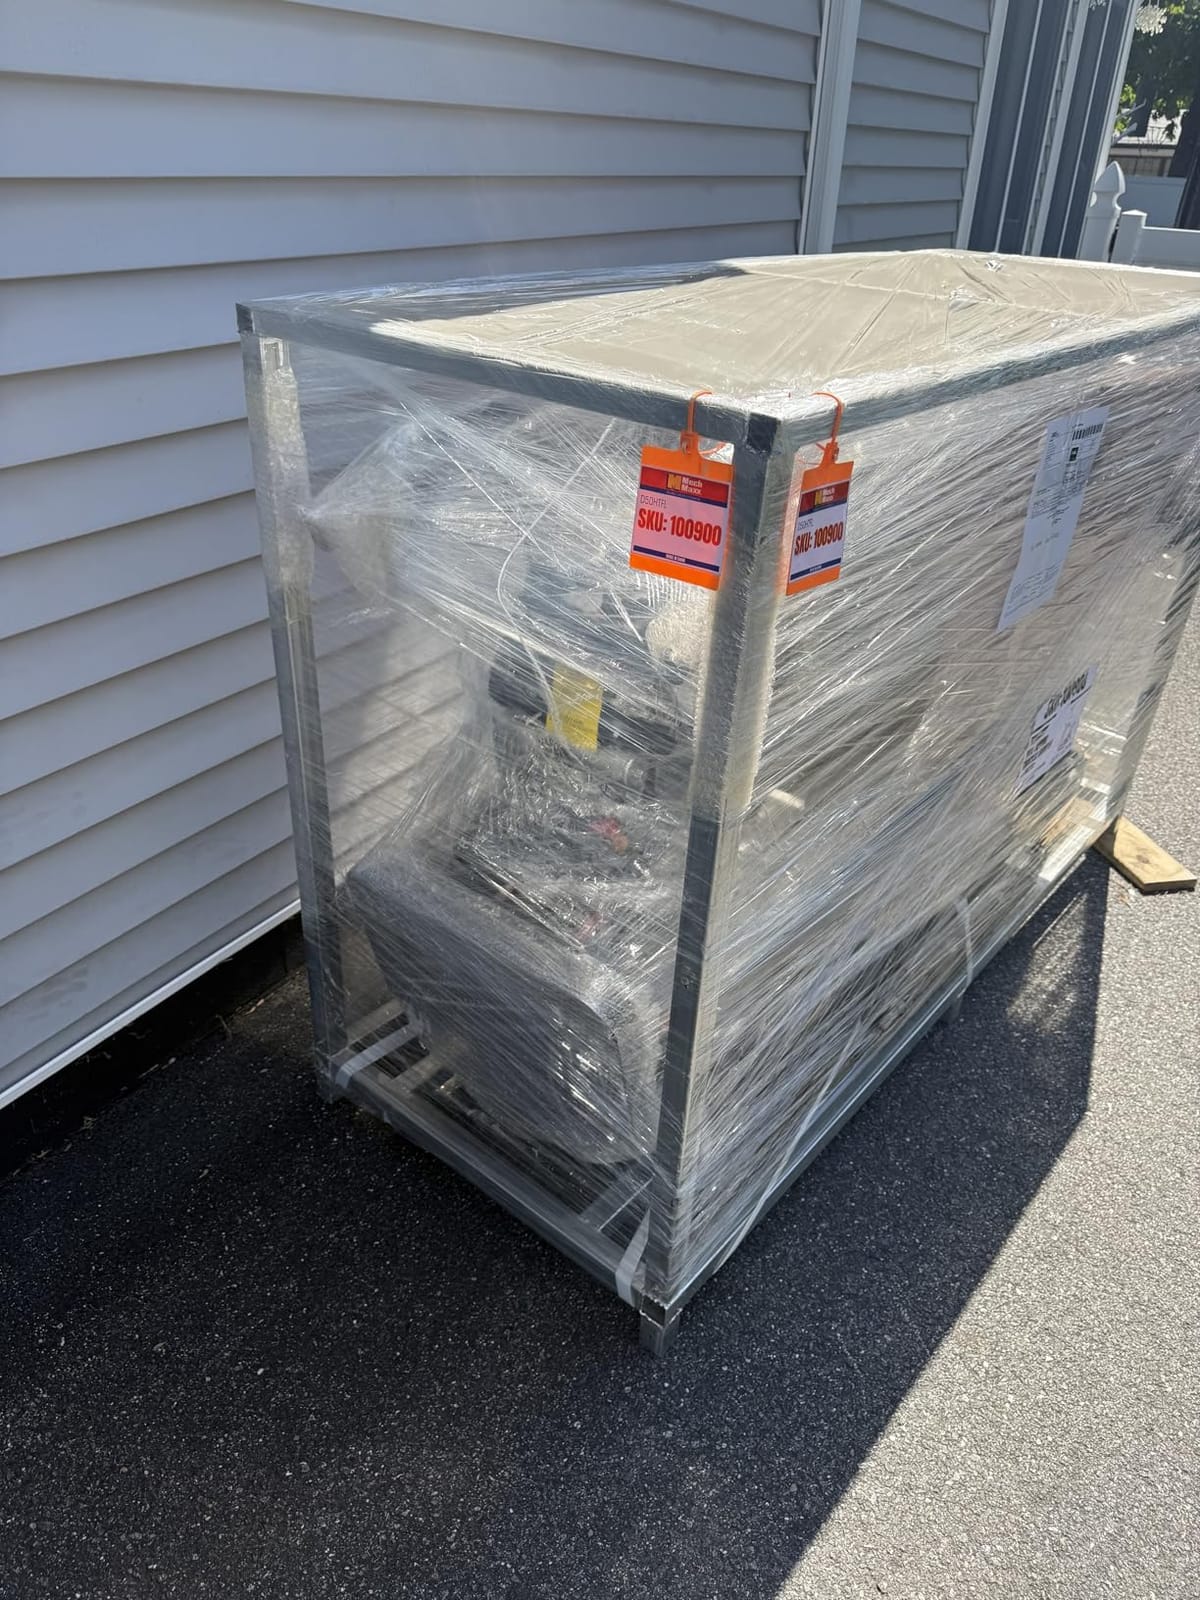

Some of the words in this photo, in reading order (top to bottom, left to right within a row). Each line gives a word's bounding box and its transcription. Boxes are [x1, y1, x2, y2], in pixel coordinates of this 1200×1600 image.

[681, 485, 702, 495] Maxx
[682, 476, 703, 488] Mech
[637, 508, 667, 532] SKU:
[670, 515, 722, 546] 100900
[794, 534, 813, 556] SKU:
[814, 521, 843, 548] 100900
